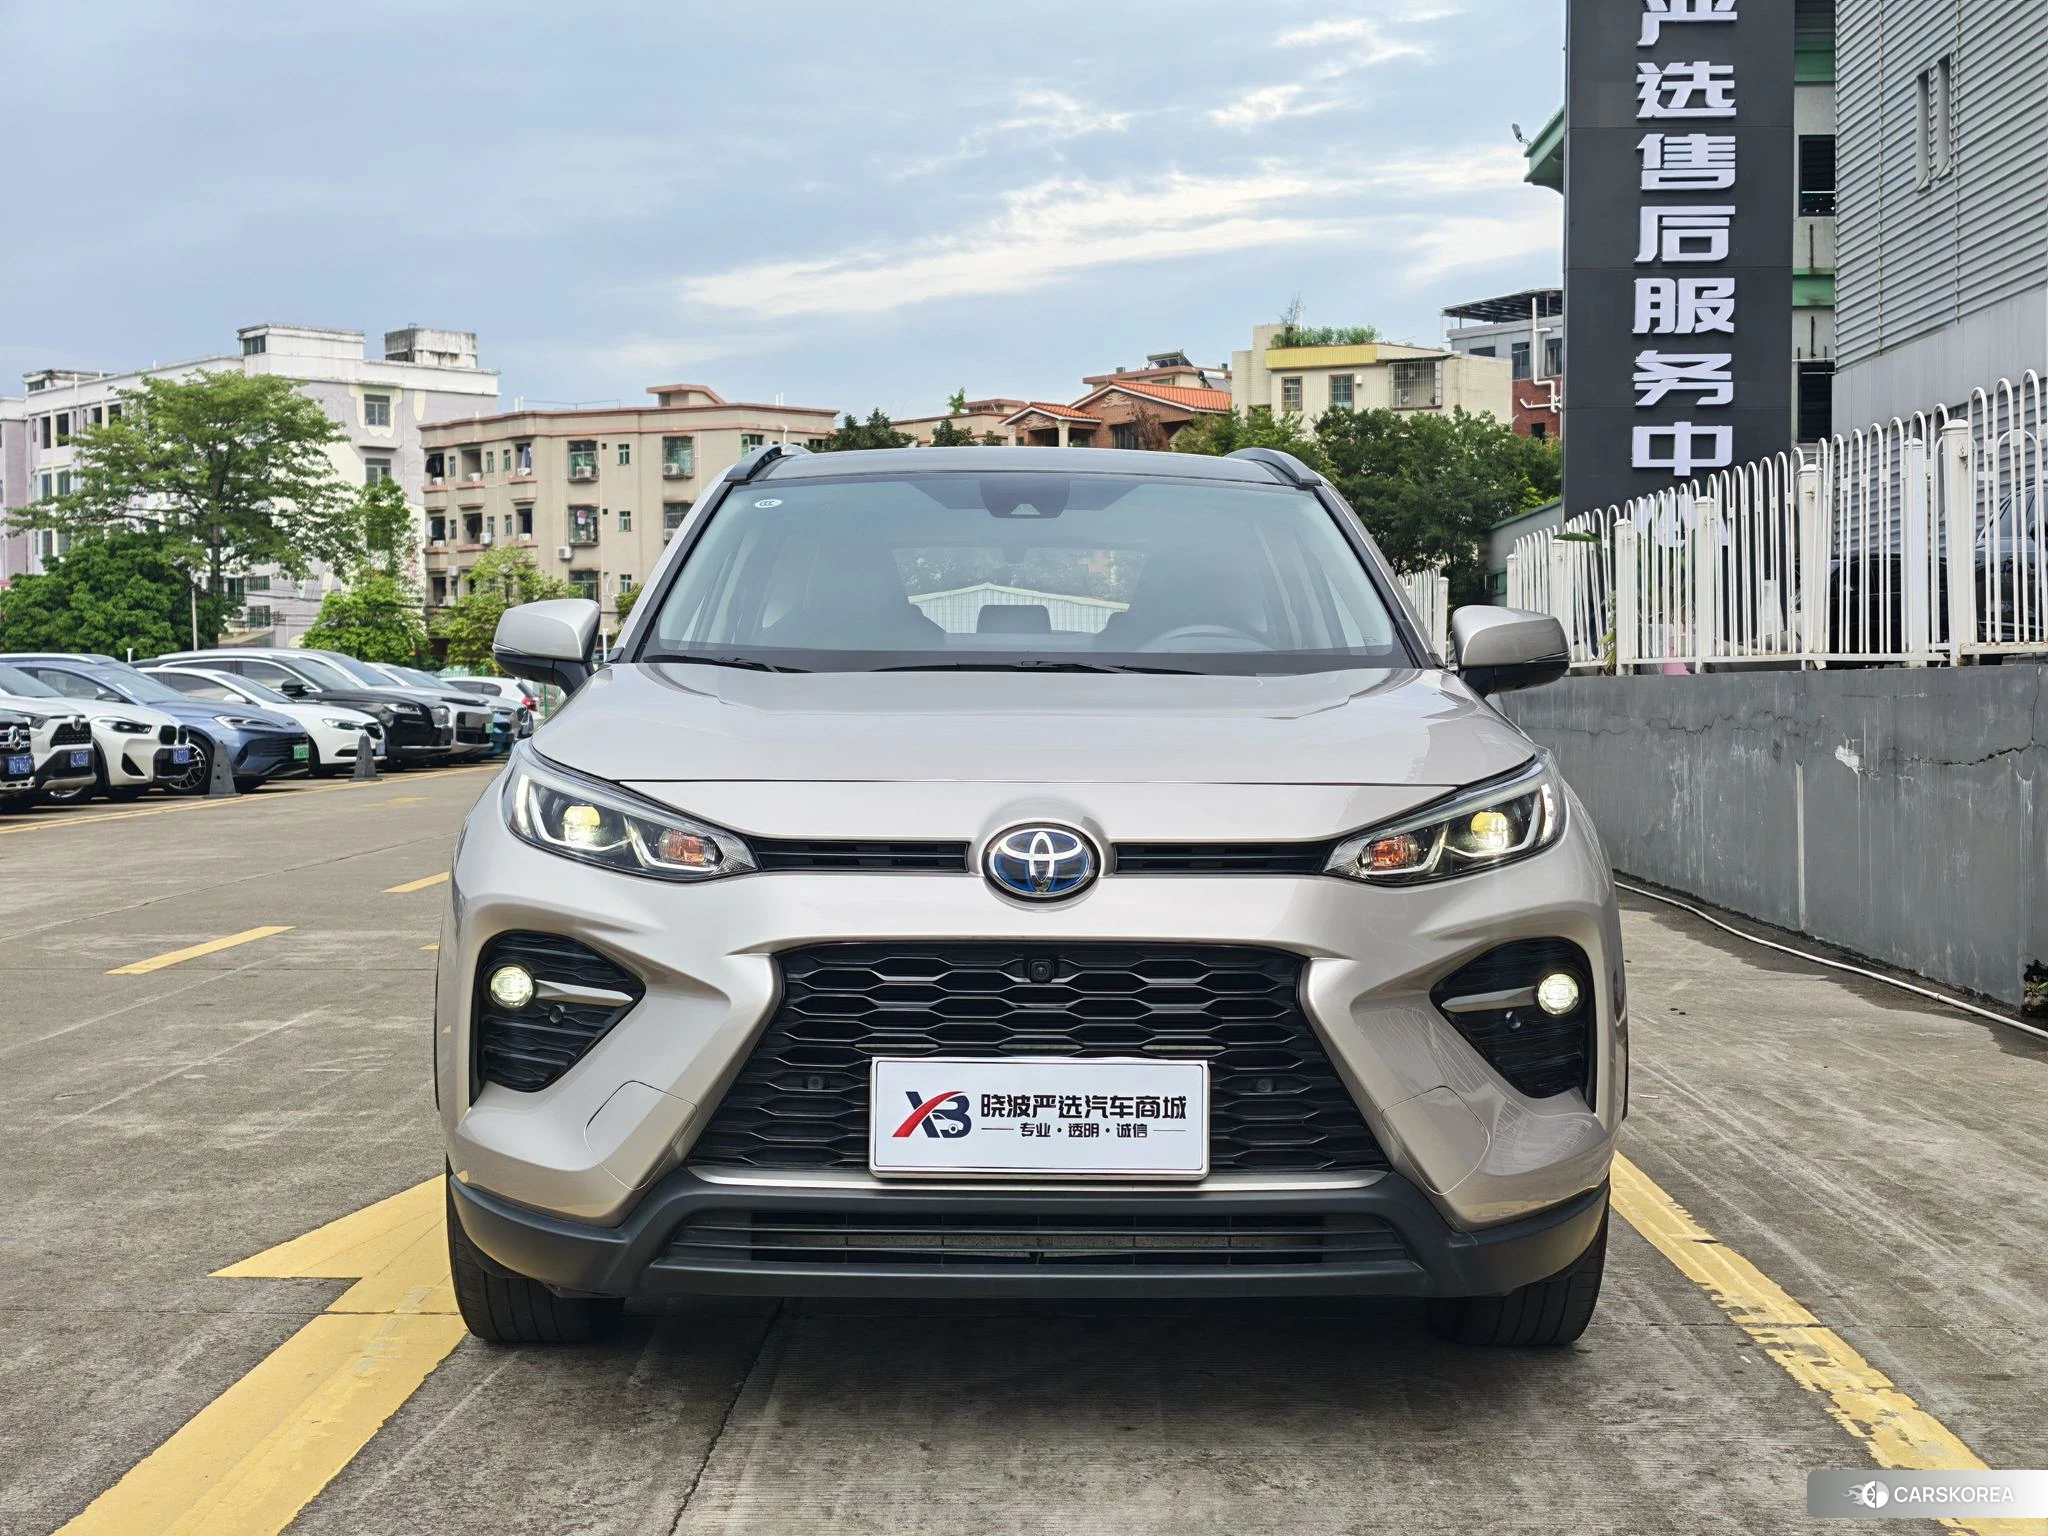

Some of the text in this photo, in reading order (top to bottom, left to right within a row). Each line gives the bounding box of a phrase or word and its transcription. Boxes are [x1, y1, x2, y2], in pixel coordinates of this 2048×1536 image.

[980, 1094, 1187, 1119] 晓波严选汽车商城
